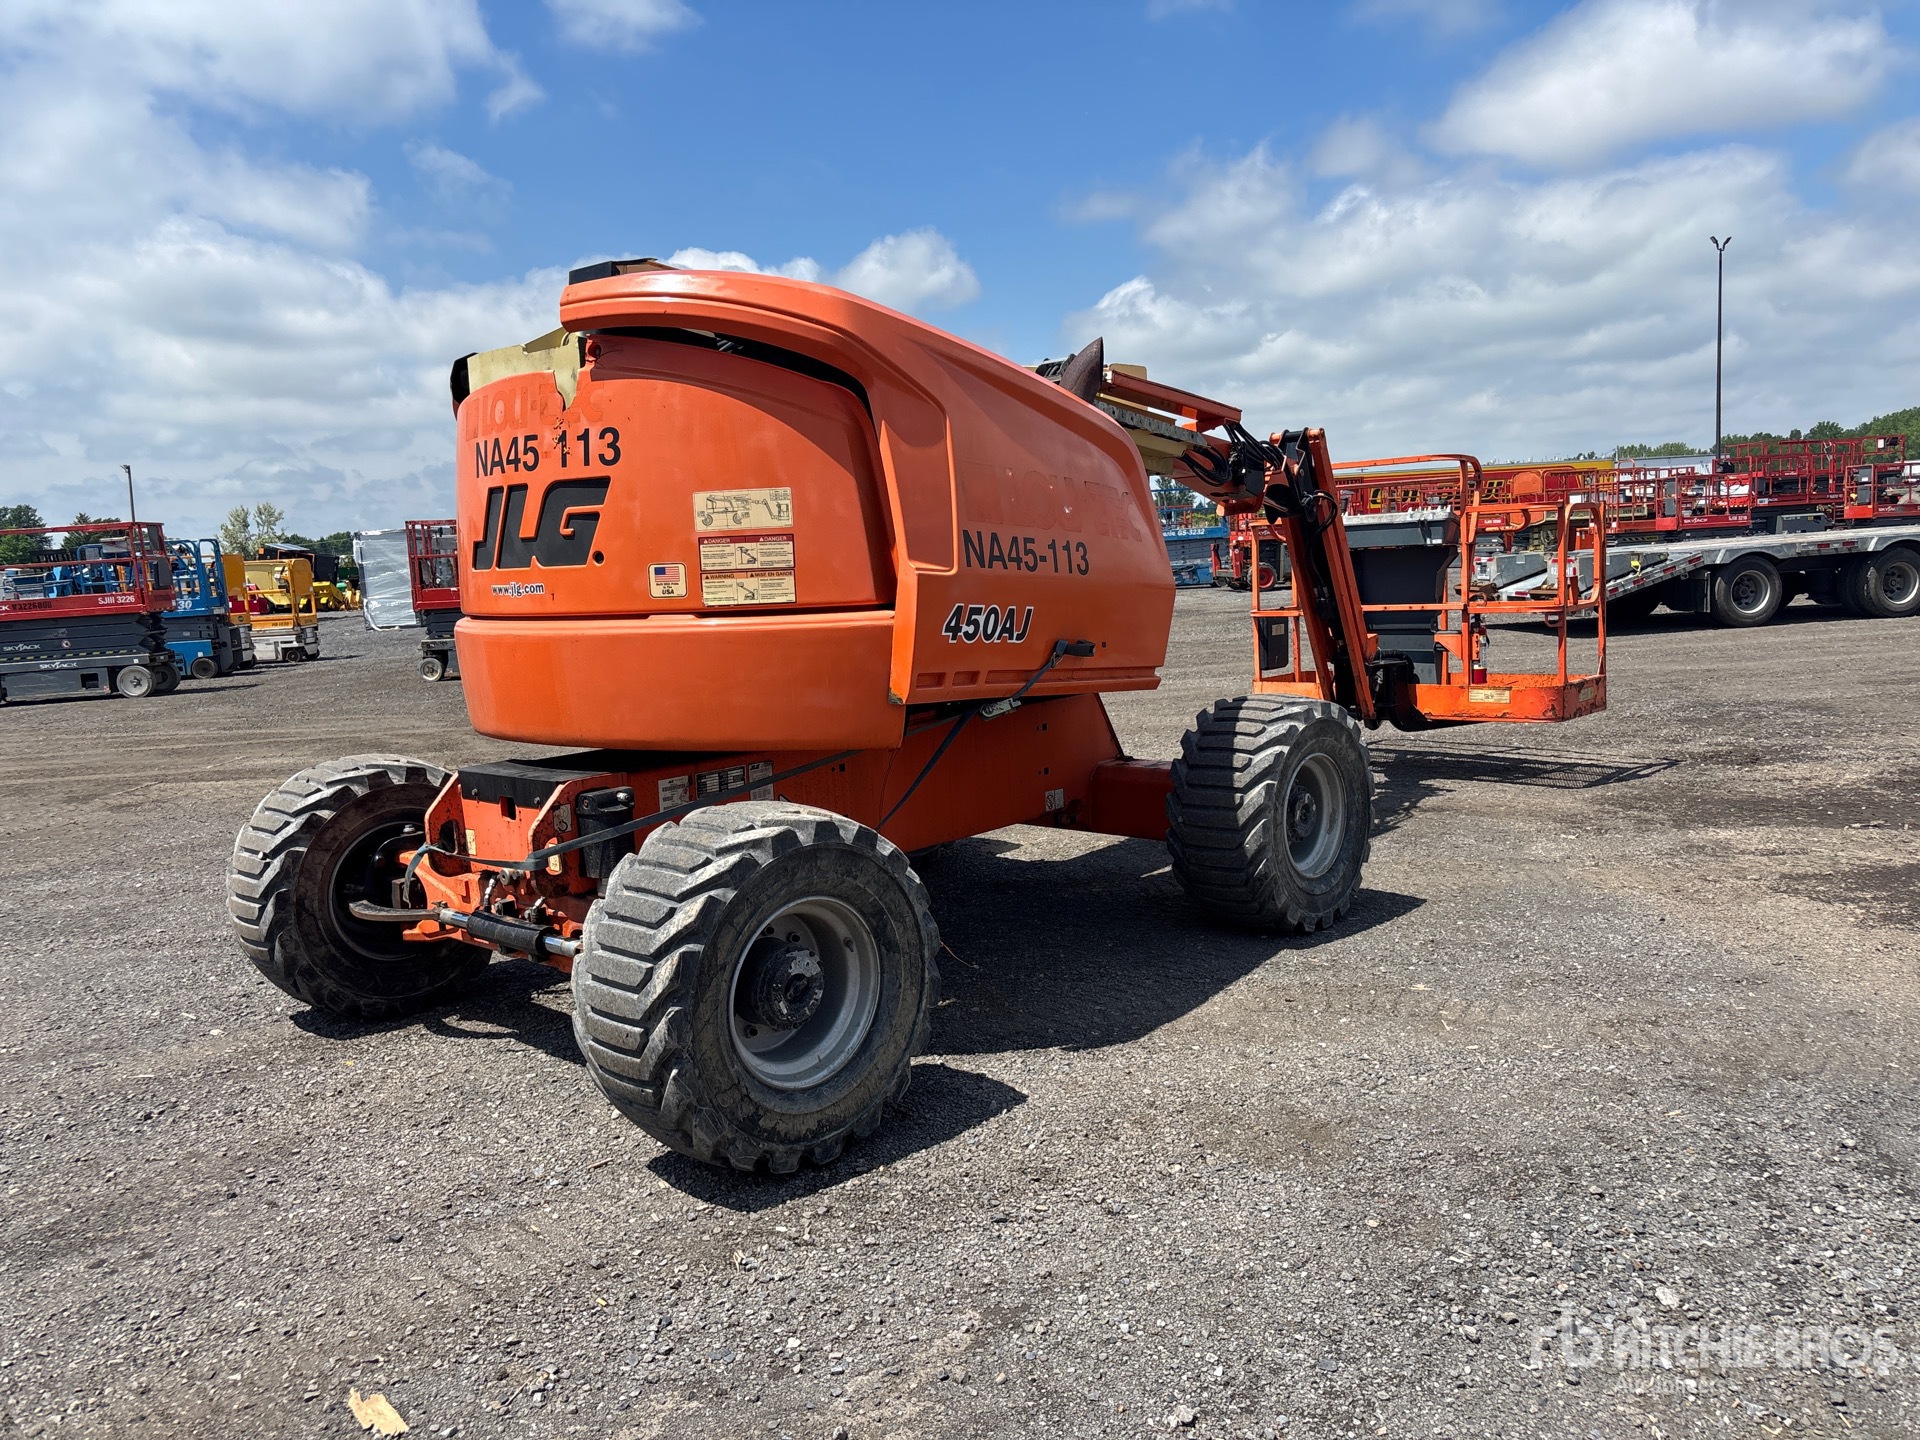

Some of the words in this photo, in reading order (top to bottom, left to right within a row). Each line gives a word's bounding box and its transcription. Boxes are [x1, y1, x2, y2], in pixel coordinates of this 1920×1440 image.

[475, 433, 540, 478] NA45
[557, 427, 621, 469] 113
[1177, 528, 1206, 537] GS-3232
[962, 529, 1090, 576] NA45-113
[491, 582, 544, 597] www.jlg.com
[116, 594, 136, 604] 3226
[942, 603, 1034, 644] 450AJ
[2, 643, 41, 651] SKYJACK
[39, 661, 79, 670] SKYJACK
